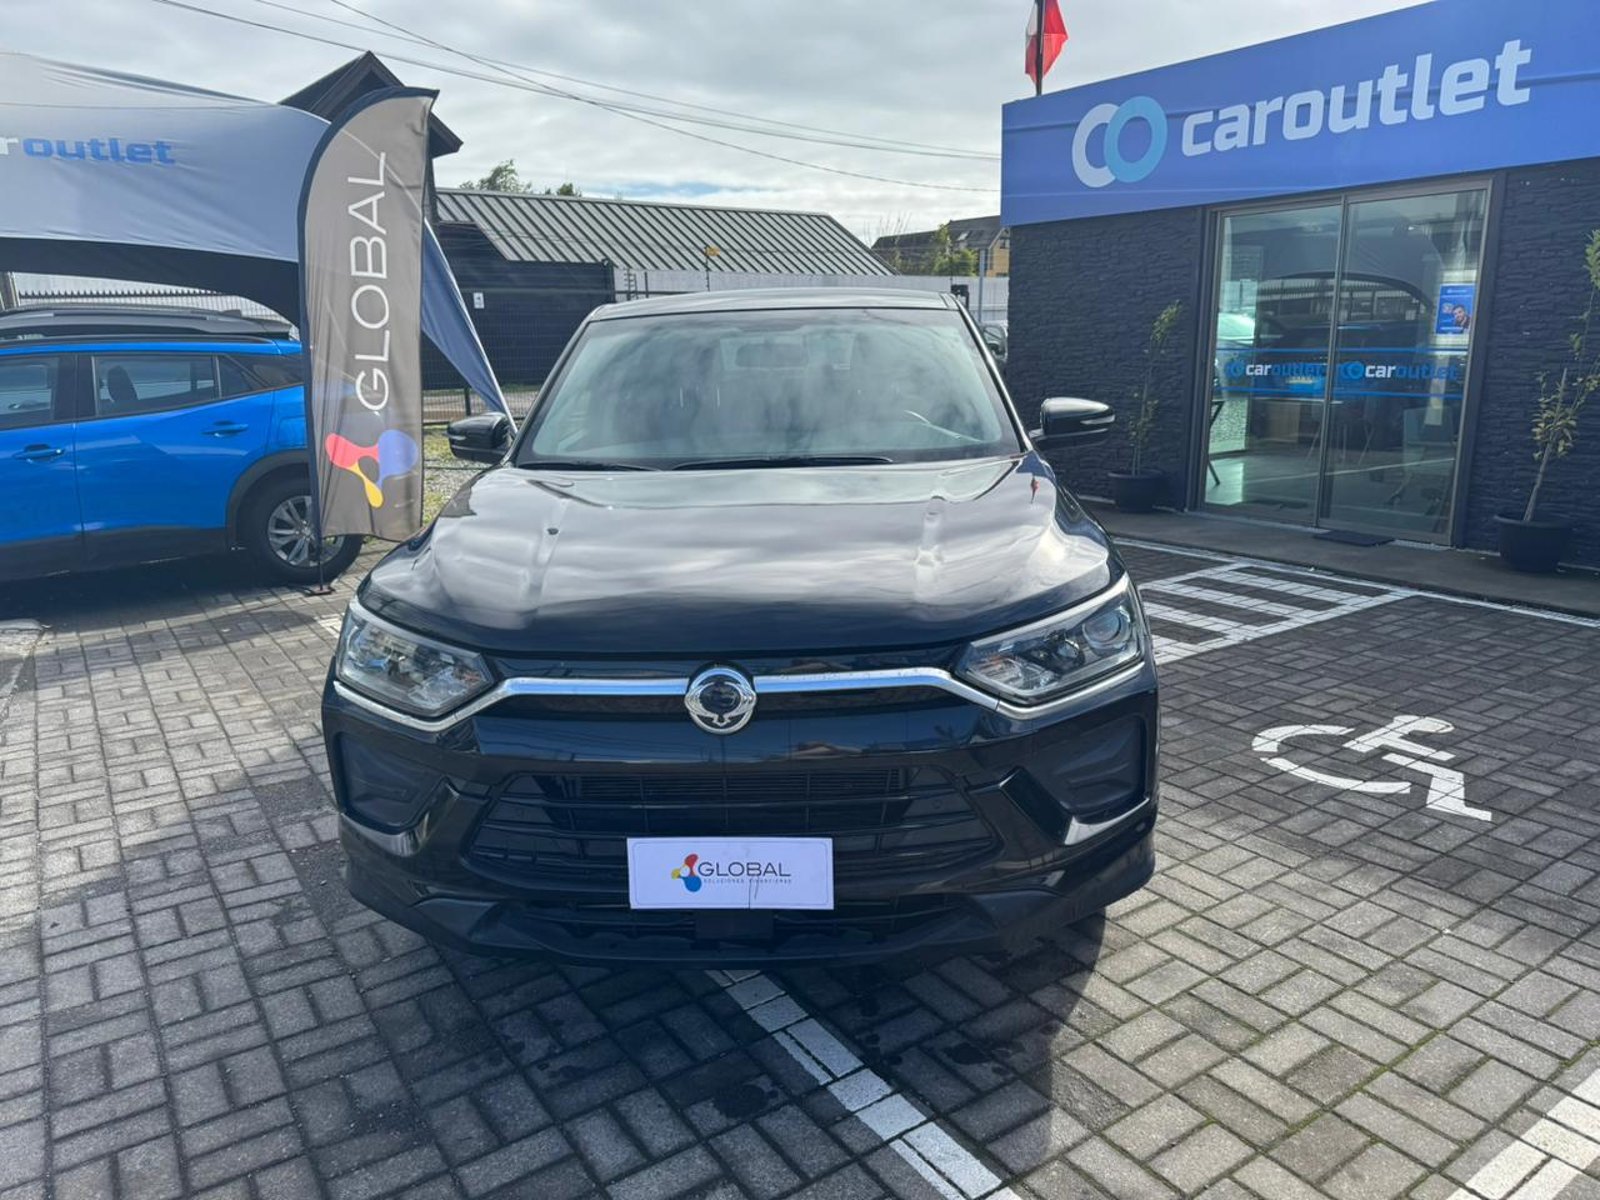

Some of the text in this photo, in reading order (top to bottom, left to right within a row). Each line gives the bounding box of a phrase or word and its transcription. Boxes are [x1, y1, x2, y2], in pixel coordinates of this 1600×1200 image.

[1181, 39, 1532, 157] caroutlet
[347, 152, 390, 411] GLOBAL
[698, 861, 792, 877] GLOBAL
